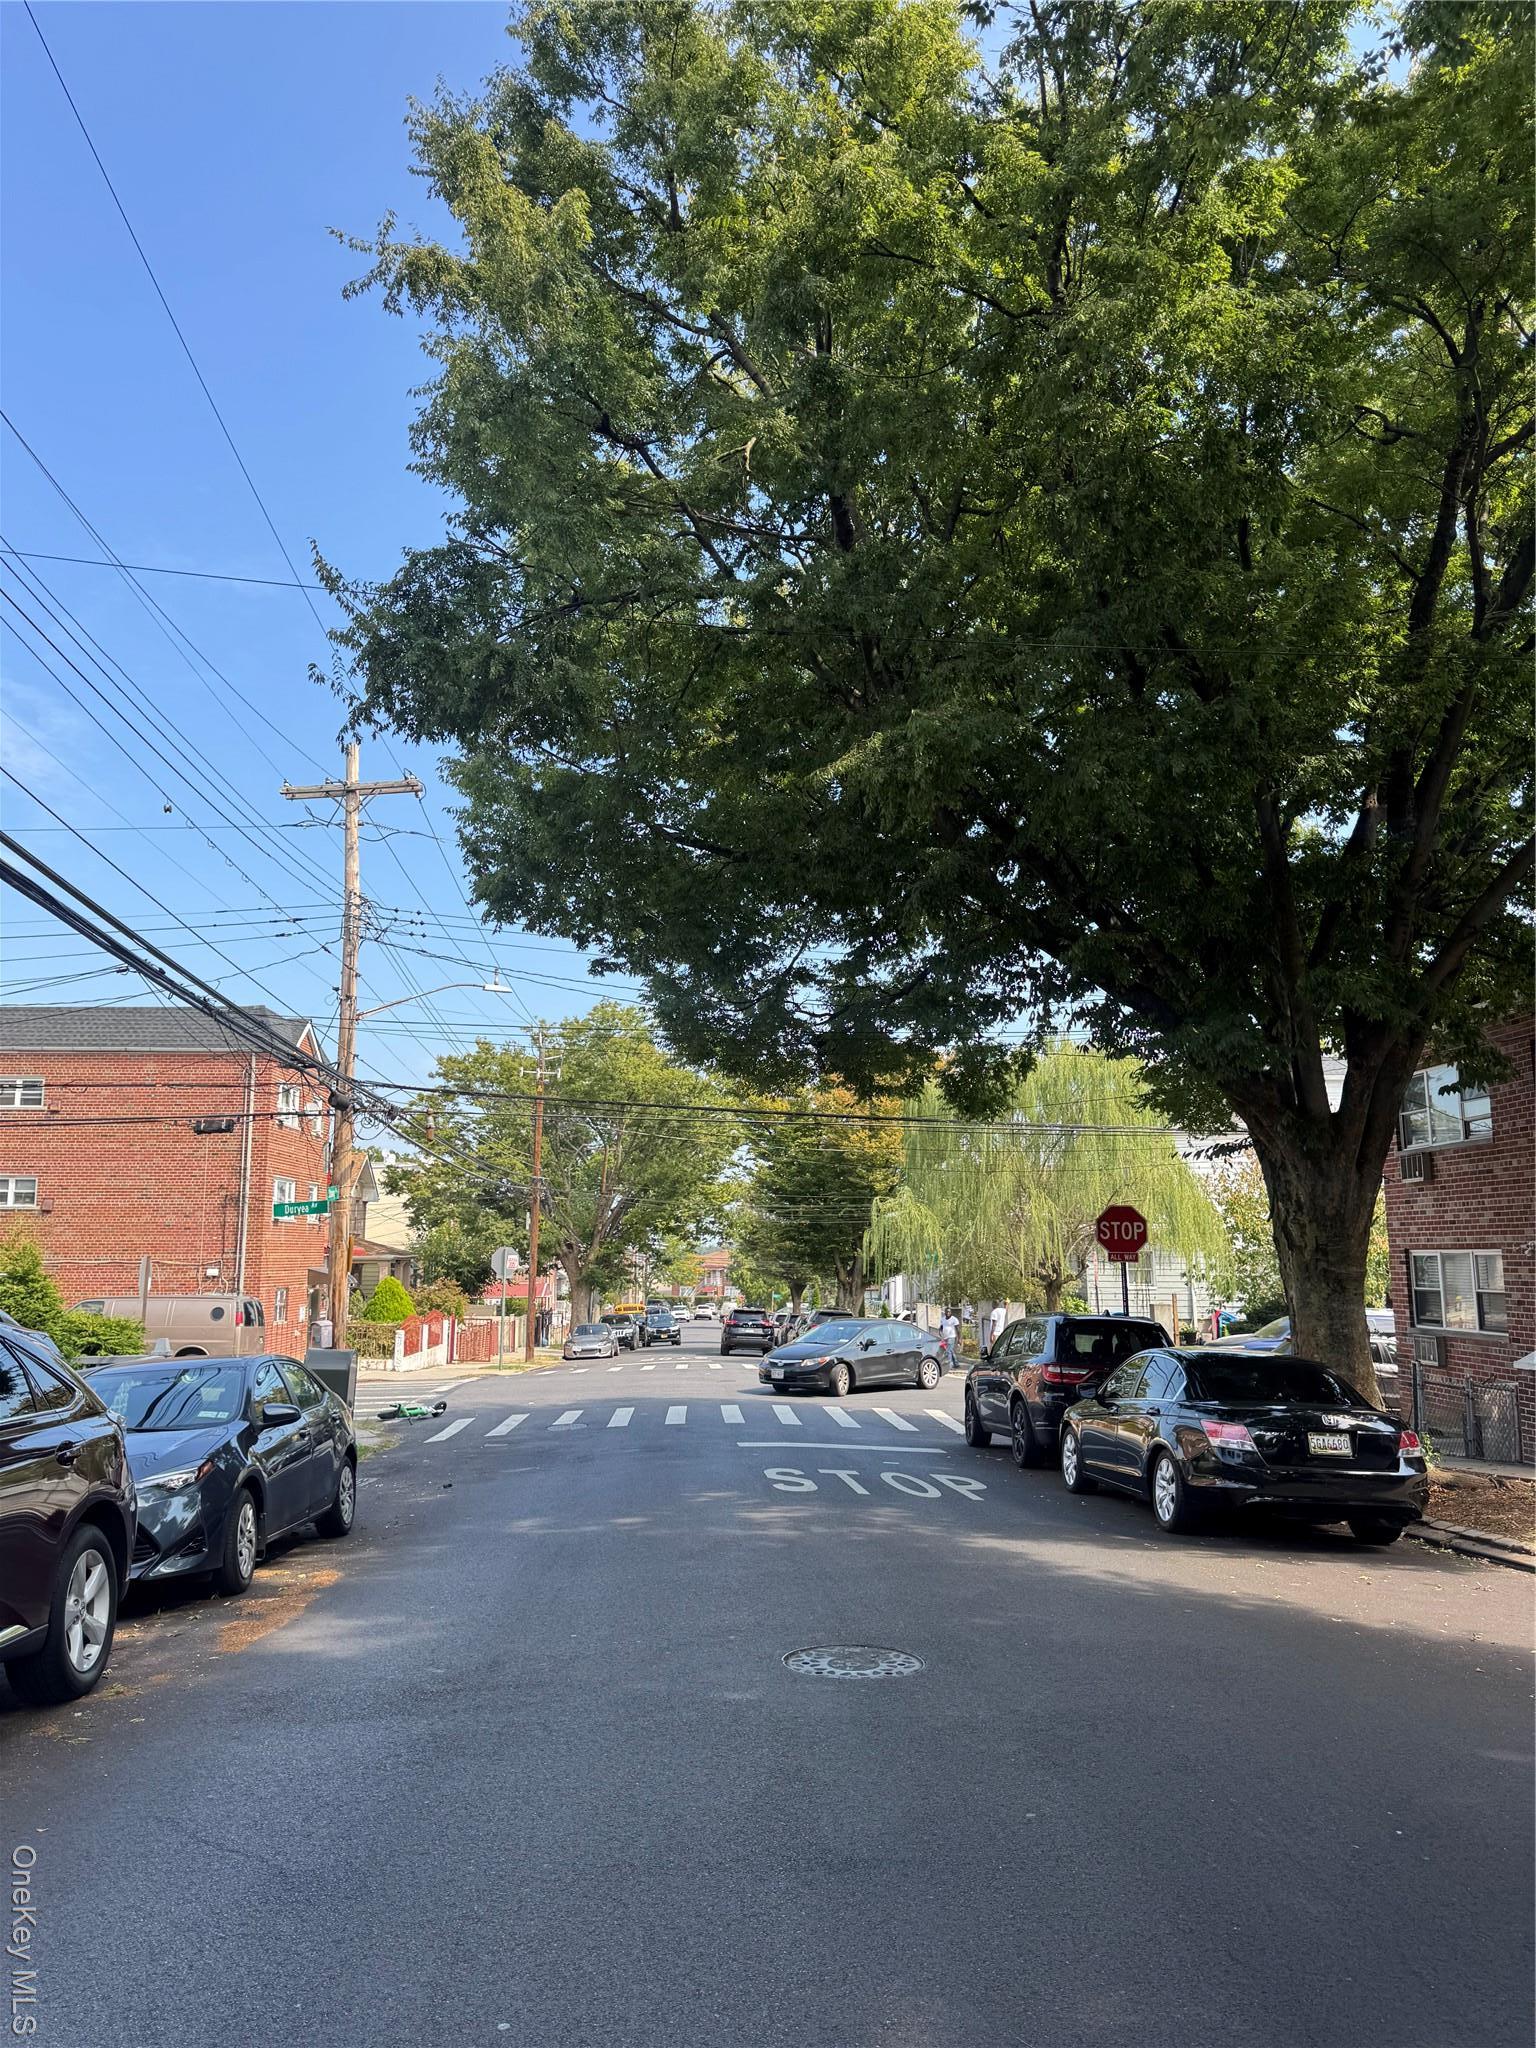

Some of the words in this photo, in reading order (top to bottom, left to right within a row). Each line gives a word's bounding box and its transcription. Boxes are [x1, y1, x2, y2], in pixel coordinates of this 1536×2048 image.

[284, 1204, 309, 1215] Duryea
[1100, 1221, 1144, 1240] STOP
[1110, 1253, 1122, 1261] ALL
[763, 1467, 988, 1501] STOP
